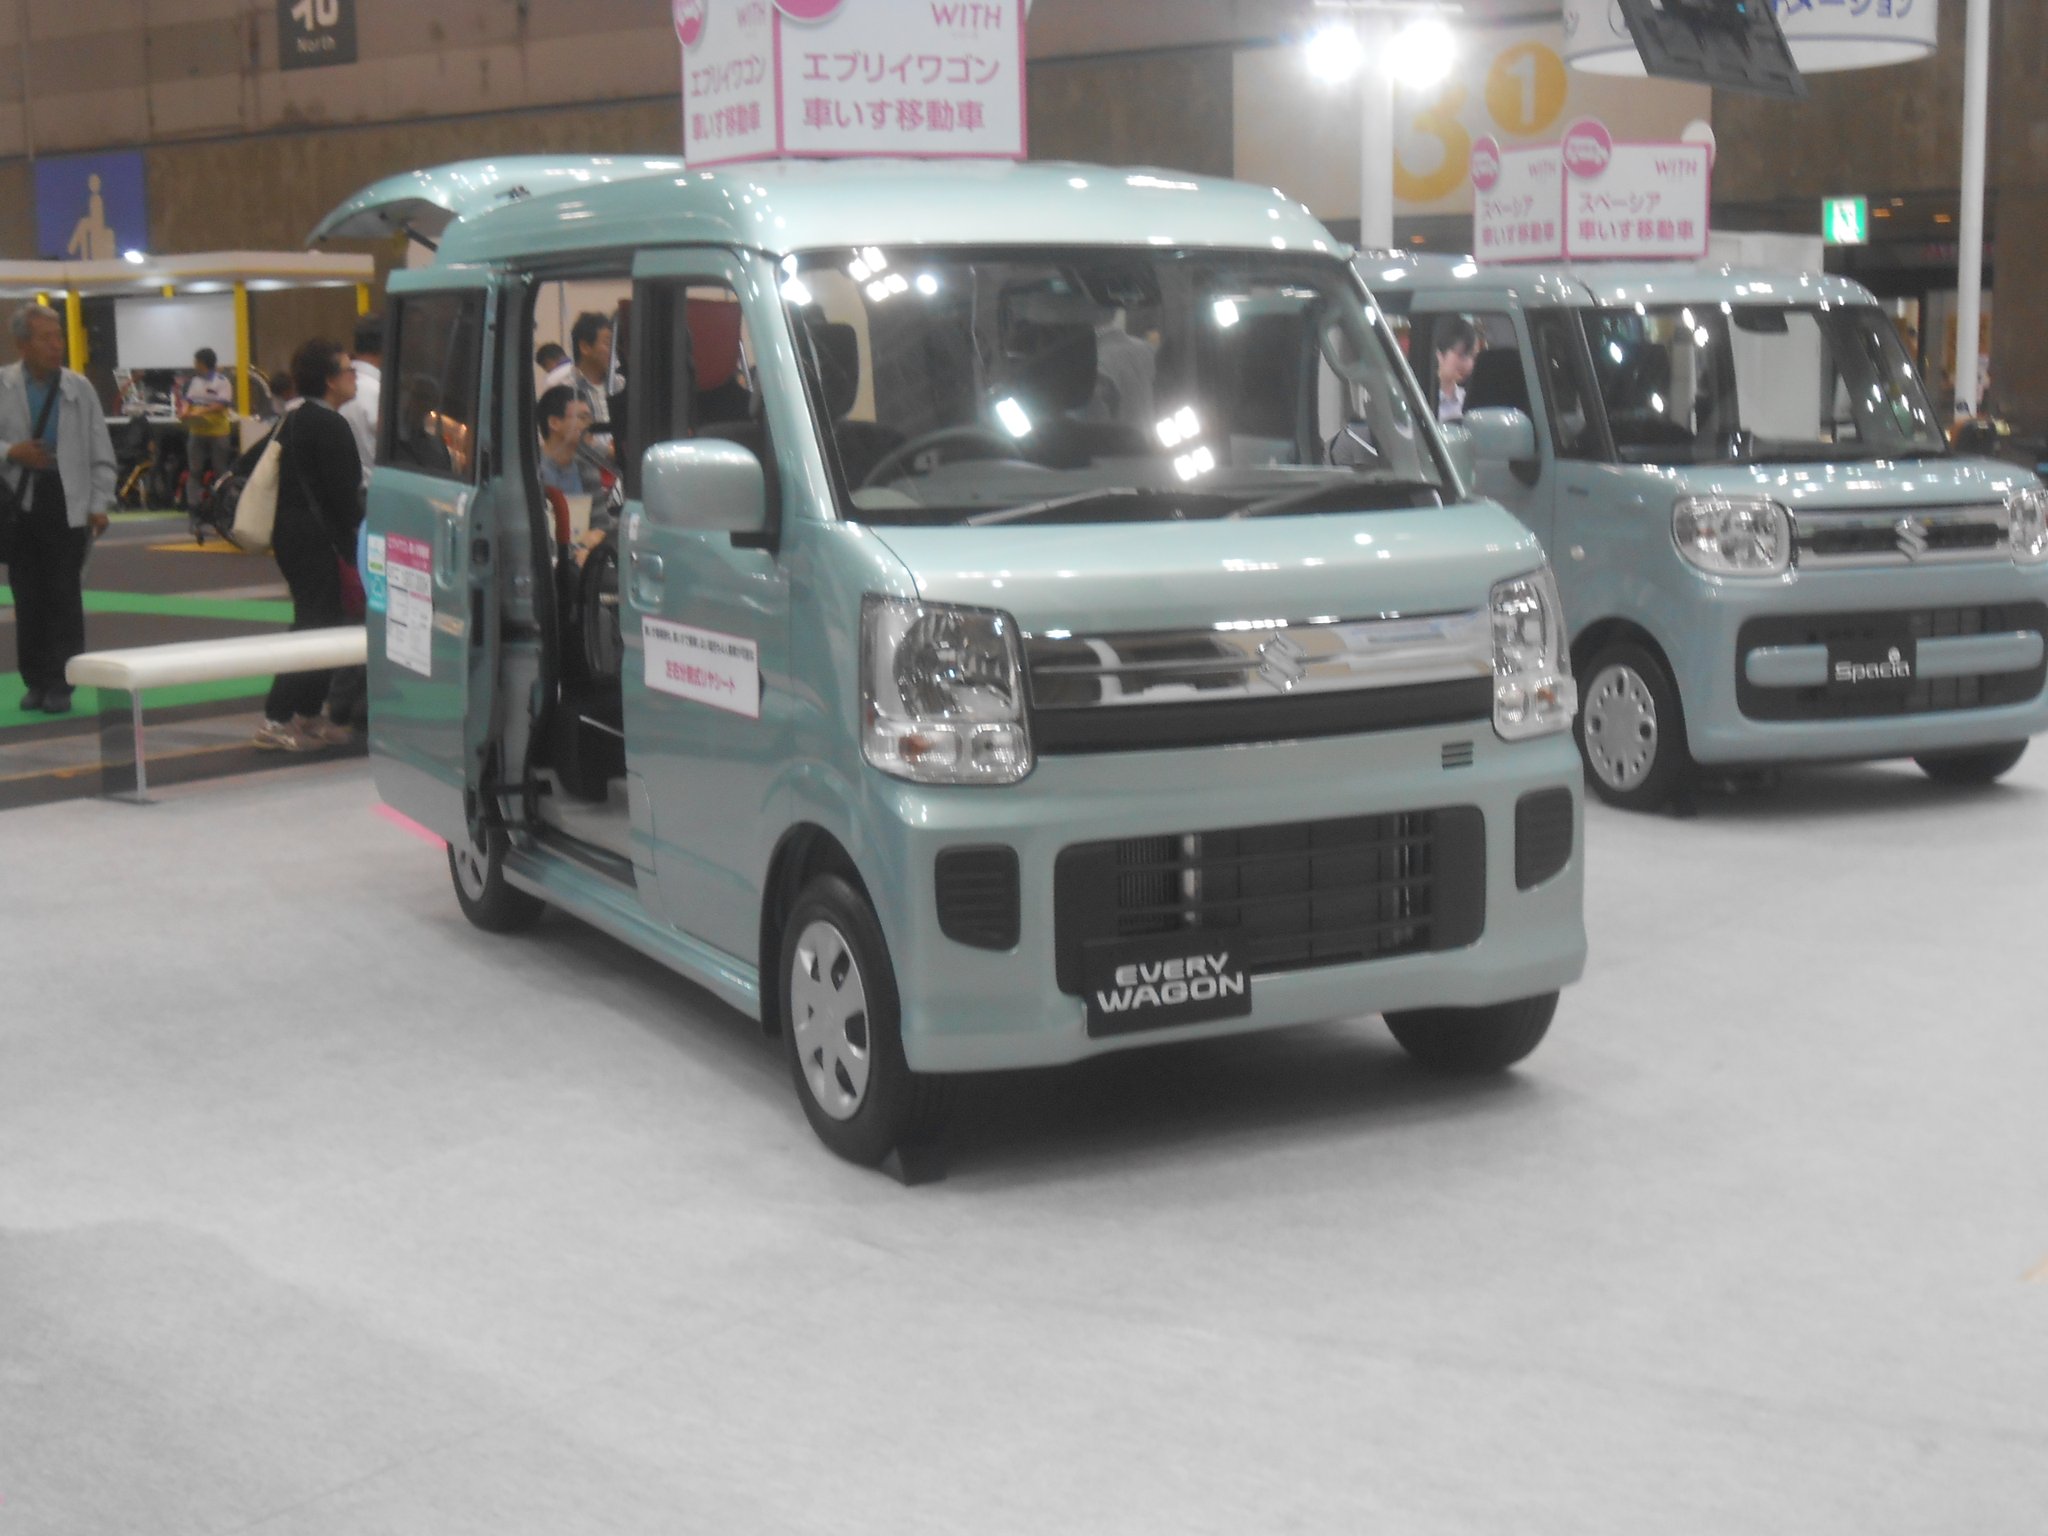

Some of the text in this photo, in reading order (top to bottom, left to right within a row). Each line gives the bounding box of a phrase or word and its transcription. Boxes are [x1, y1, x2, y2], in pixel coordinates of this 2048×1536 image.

[291, 0, 339, 31] 10
[931, 2, 1002, 29] WITH
[803, 50, 1001, 84] エブリイワゴン
[803, 97, 986, 132] 車いす移動車
[1655, 158, 1698, 176] WITH
[1115, 951, 1229, 987] EVERY
[1096, 971, 1245, 1013] WAGON
